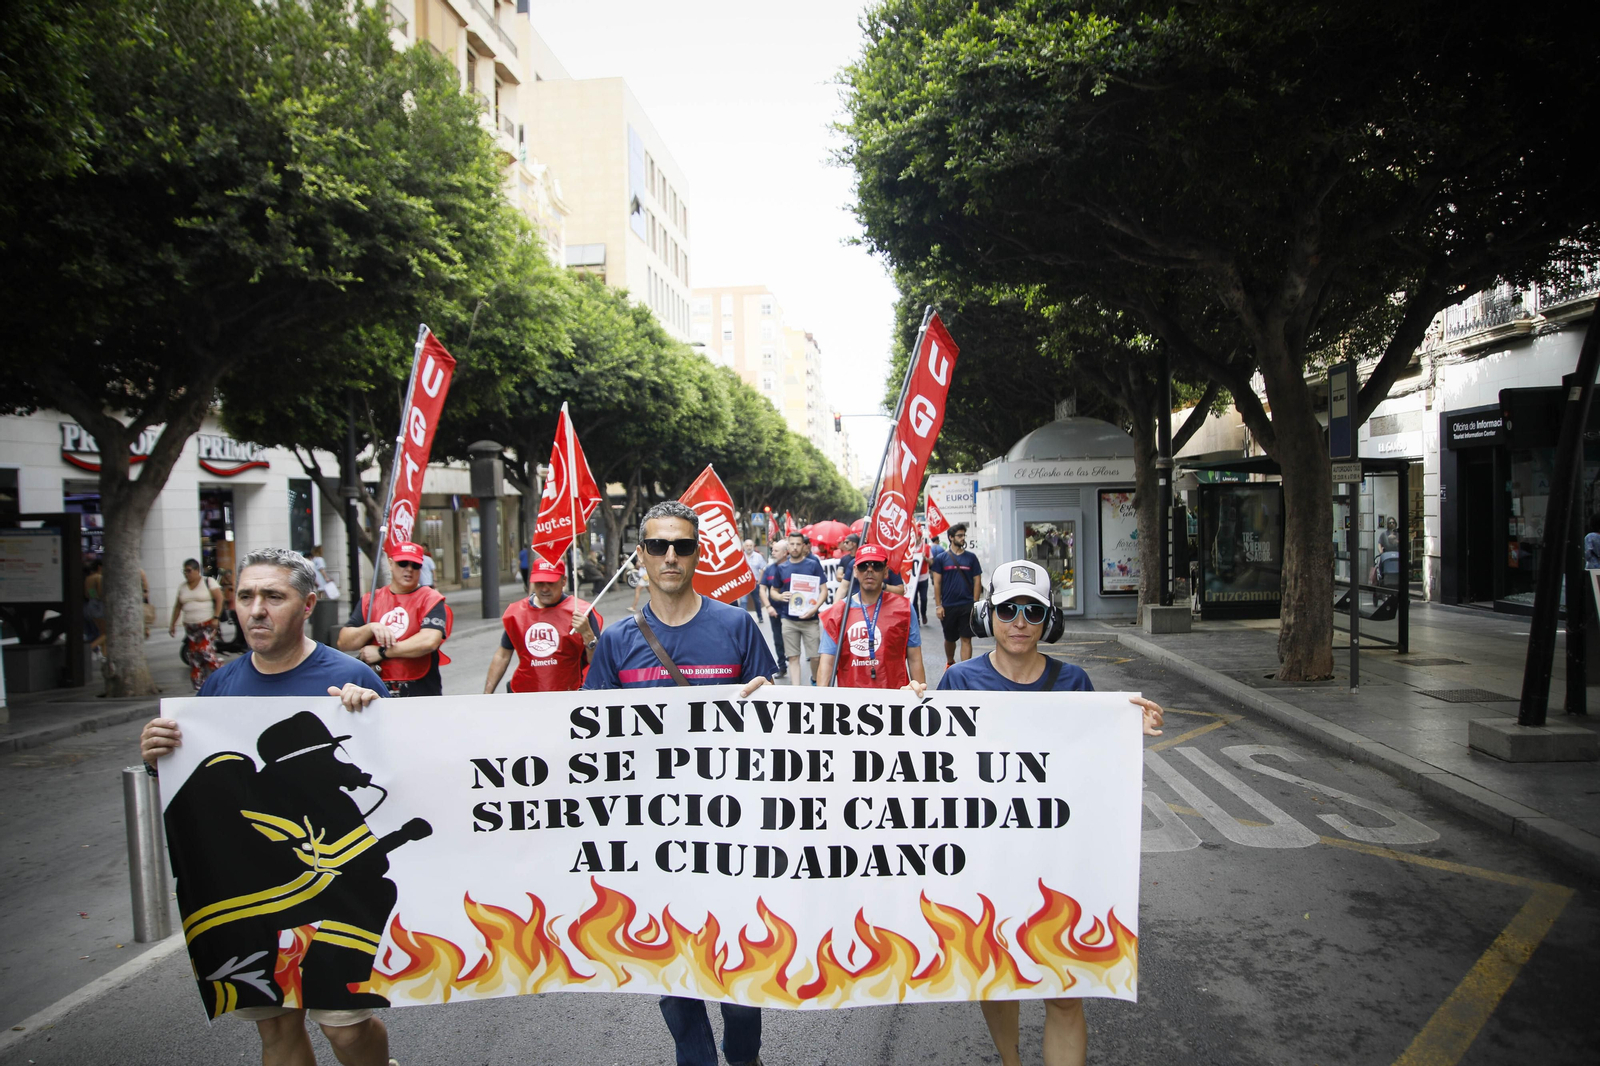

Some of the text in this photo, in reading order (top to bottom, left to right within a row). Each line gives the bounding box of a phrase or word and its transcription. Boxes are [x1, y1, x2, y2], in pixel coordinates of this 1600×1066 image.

[404, 354, 444, 492] UGT
[900, 340, 949, 485] UGT
[1452, 417, 1502, 432] Oficina de Informaci
[1014, 466, 1120, 479] El Kiosko de las Flores
[698, 506, 742, 560] UGT
[1243, 541, 1271, 553] MIENDO
[1204, 589, 1280, 602] Cruzcampo
[530, 628, 554, 642] UGT
[850, 627, 869, 640] UG
[695, 667, 733, 675] BOMBEROS
[570, 698, 981, 740] SIN INVERSIÓN
[469, 747, 1051, 790] NO SE PUEDE DAR UN
[471, 793, 1072, 834] SERVICIO DE CALIDAD
[568, 840, 967, 880] AL CIUDADANO
